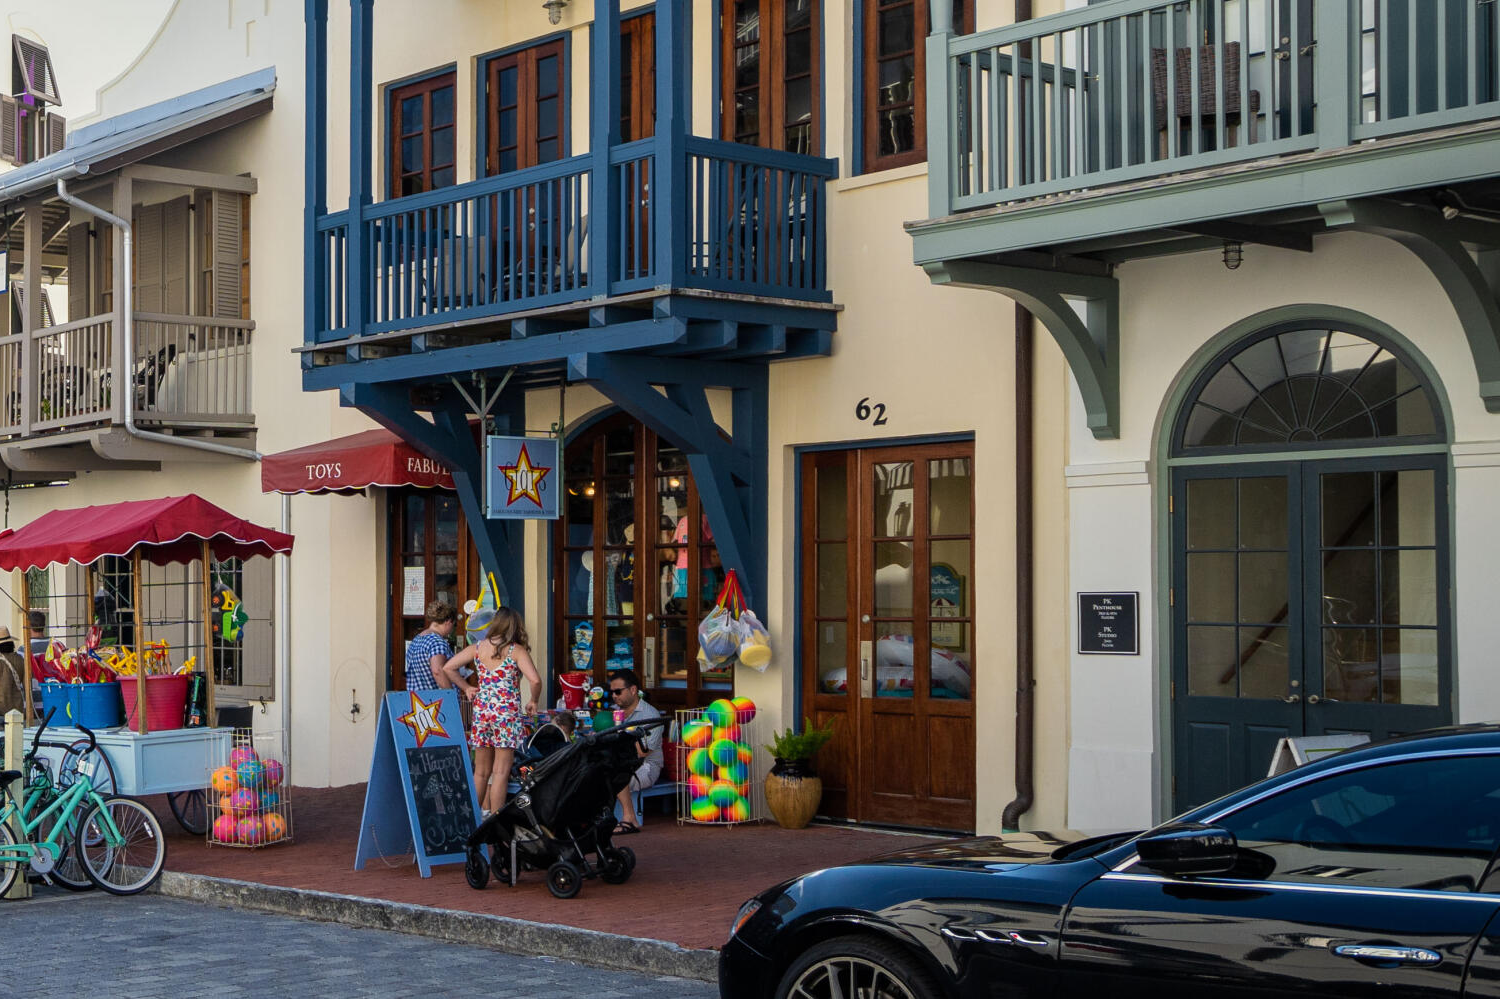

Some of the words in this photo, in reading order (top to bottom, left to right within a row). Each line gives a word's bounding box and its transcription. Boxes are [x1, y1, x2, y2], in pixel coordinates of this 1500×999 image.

[856, 397, 888, 426] 62
[305, 462, 342, 480] TOYS
[420, 749, 463, 782] Happy
[426, 816, 471, 847] July
